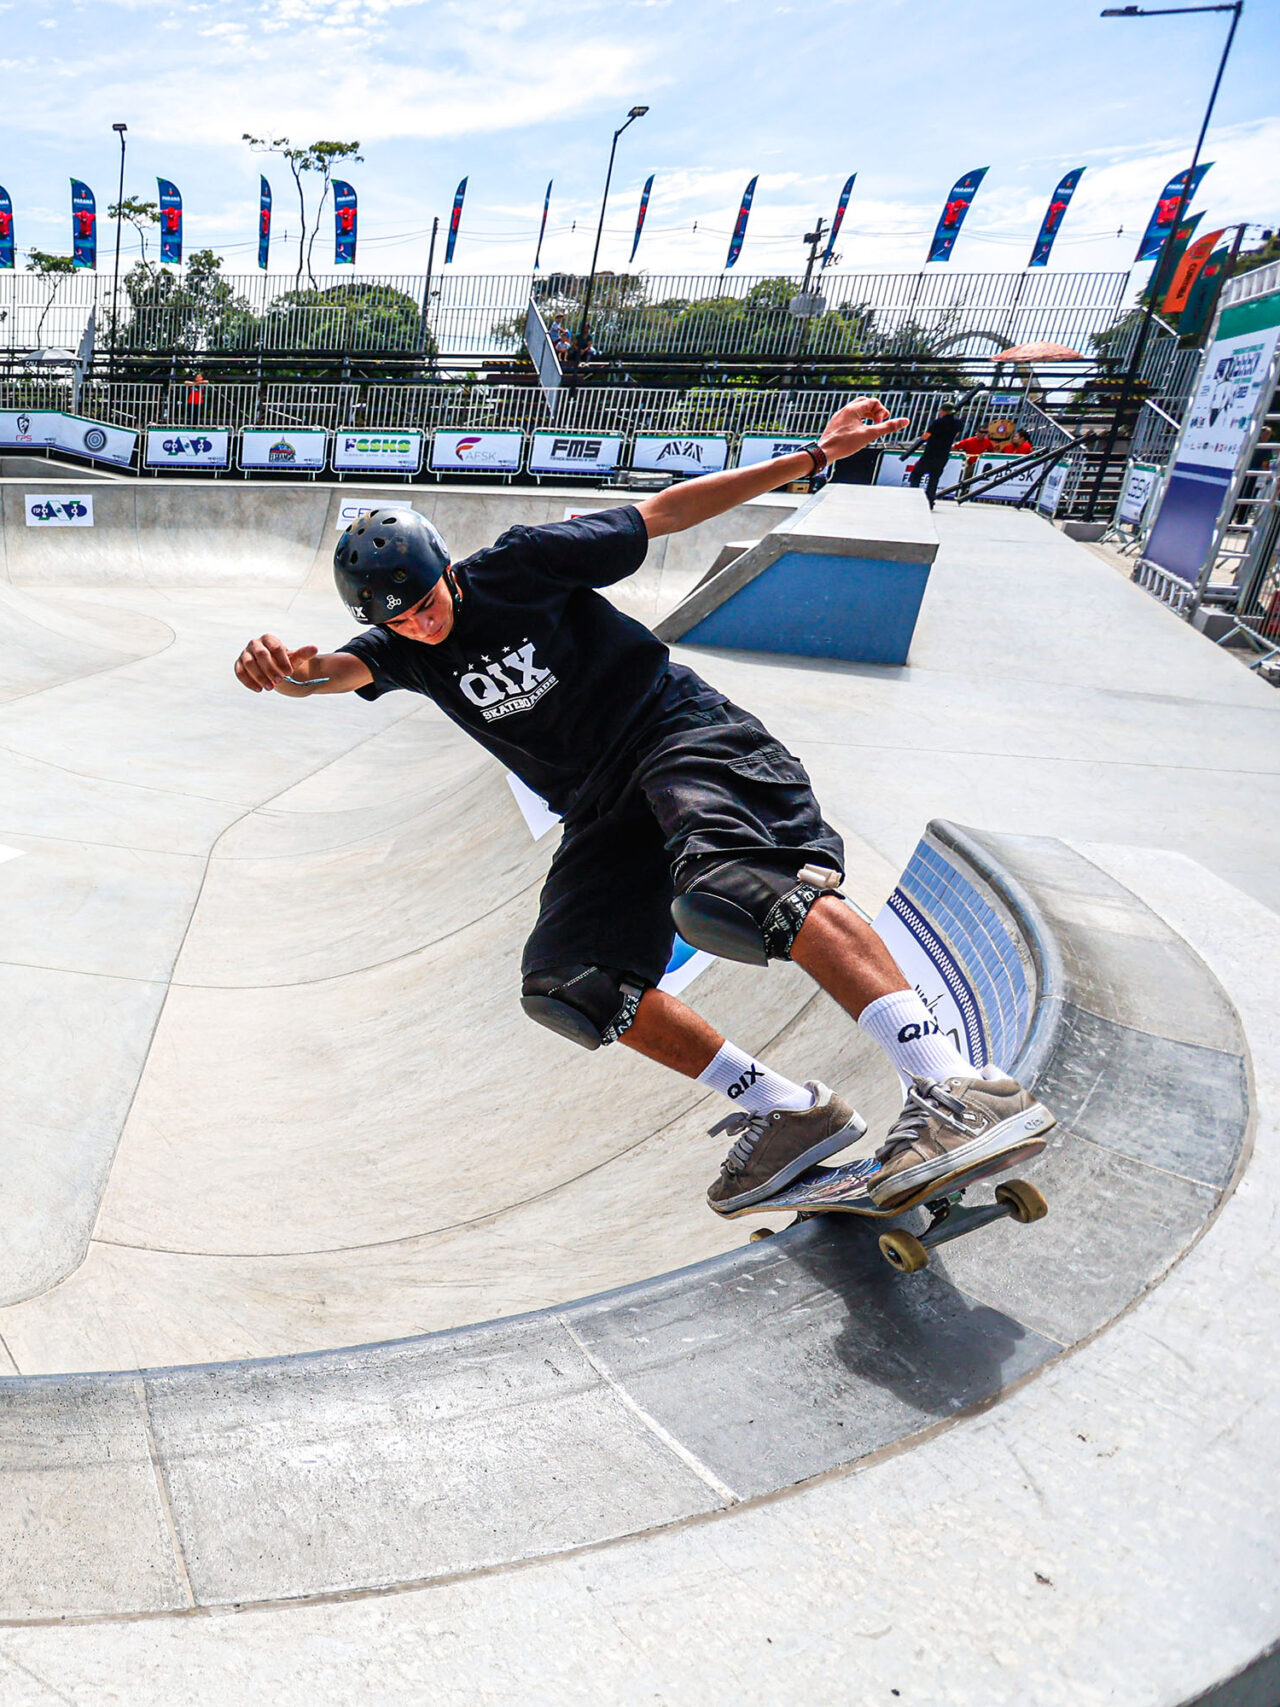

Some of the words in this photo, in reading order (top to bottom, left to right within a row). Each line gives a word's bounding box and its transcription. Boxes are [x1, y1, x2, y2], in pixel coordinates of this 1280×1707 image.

[550, 439, 602, 458] FMS
[459, 642, 552, 708] QIX
[482, 674, 558, 721] SKATEBOARDS
[727, 1063, 765, 1100] QIX
